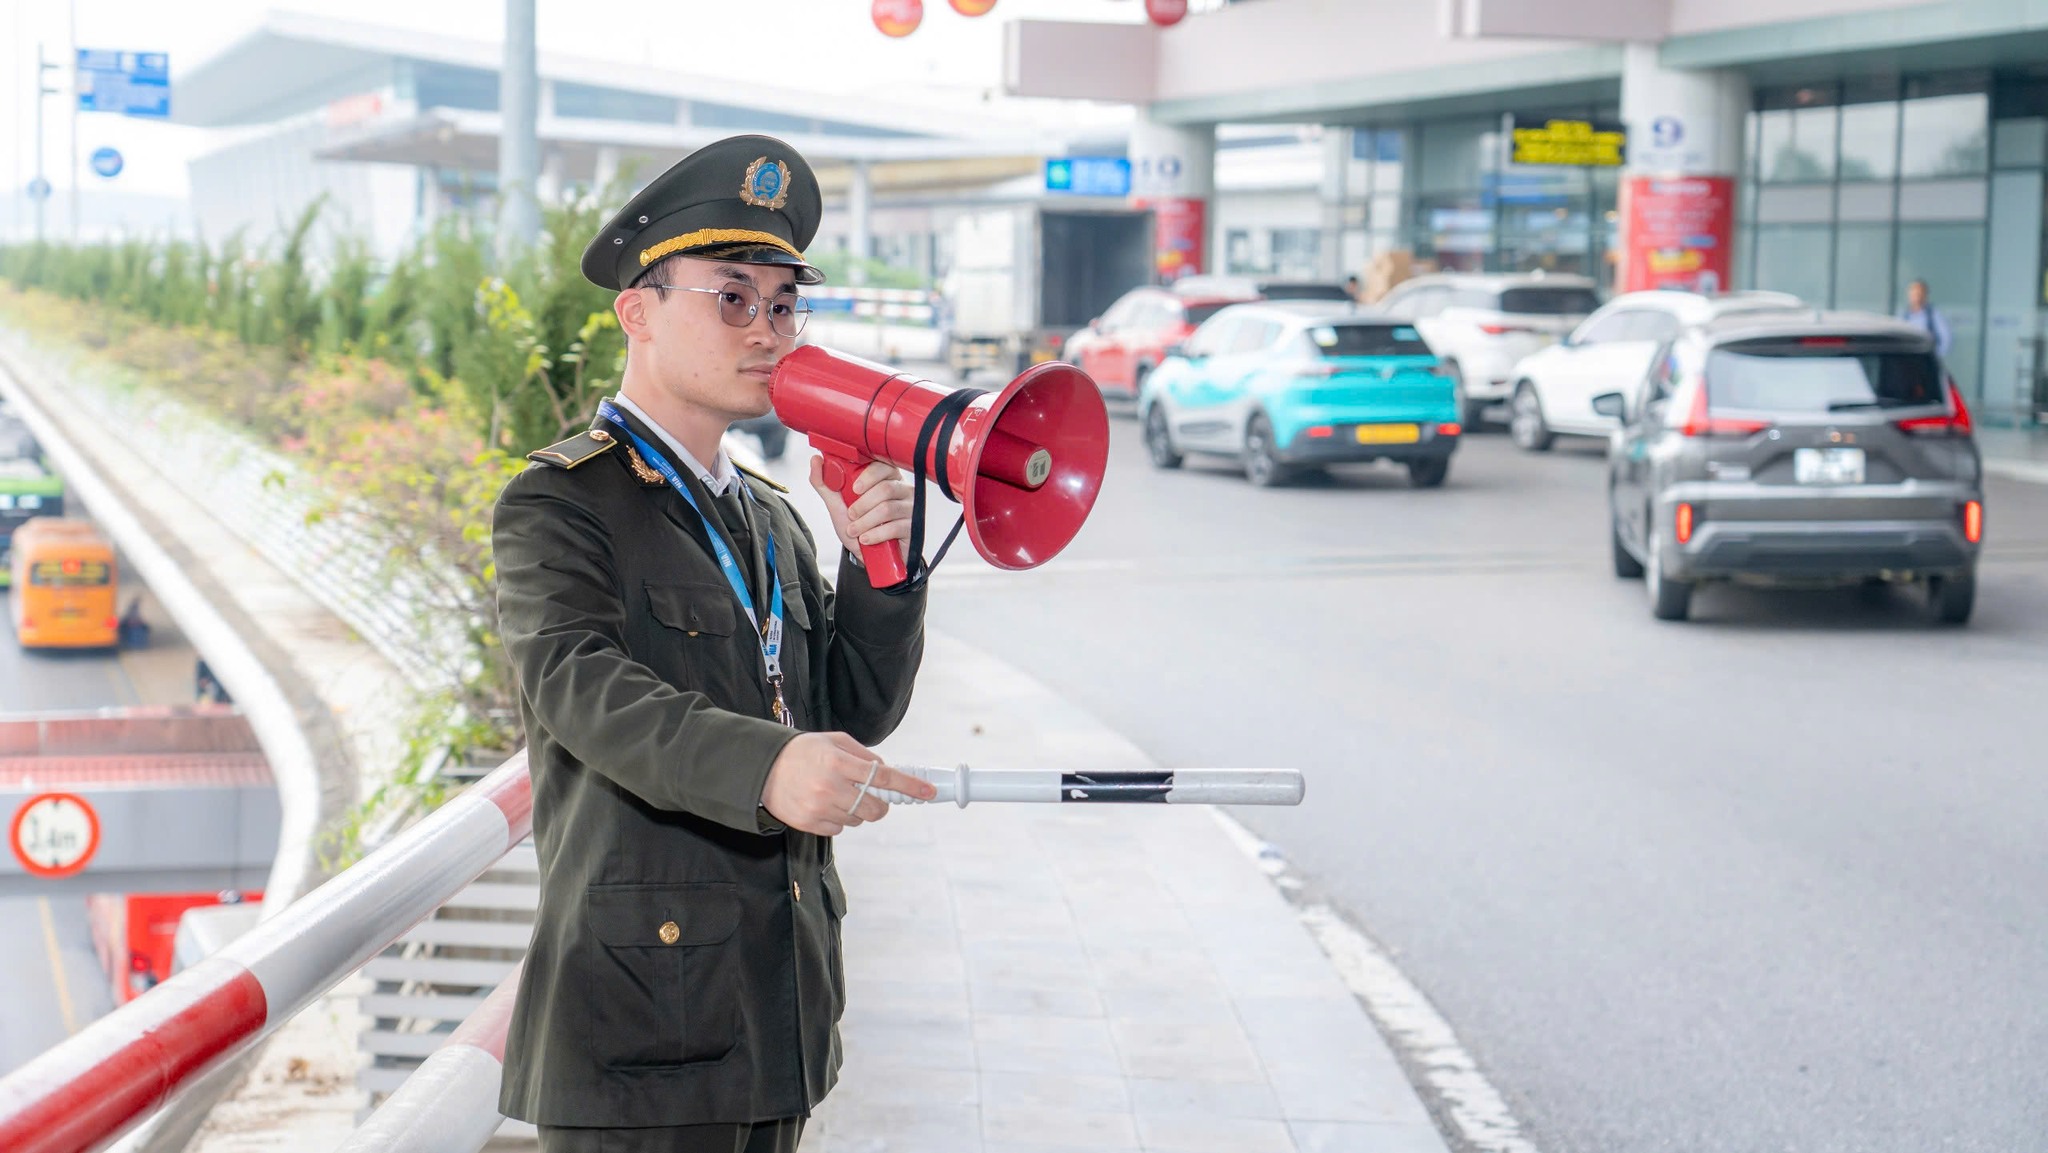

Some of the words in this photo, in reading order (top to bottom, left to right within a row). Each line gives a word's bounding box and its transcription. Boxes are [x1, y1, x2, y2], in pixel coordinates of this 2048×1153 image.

[1653, 116, 1683, 148] 9
[671, 475, 683, 489] NIA
[720, 553, 733, 568] NIA
